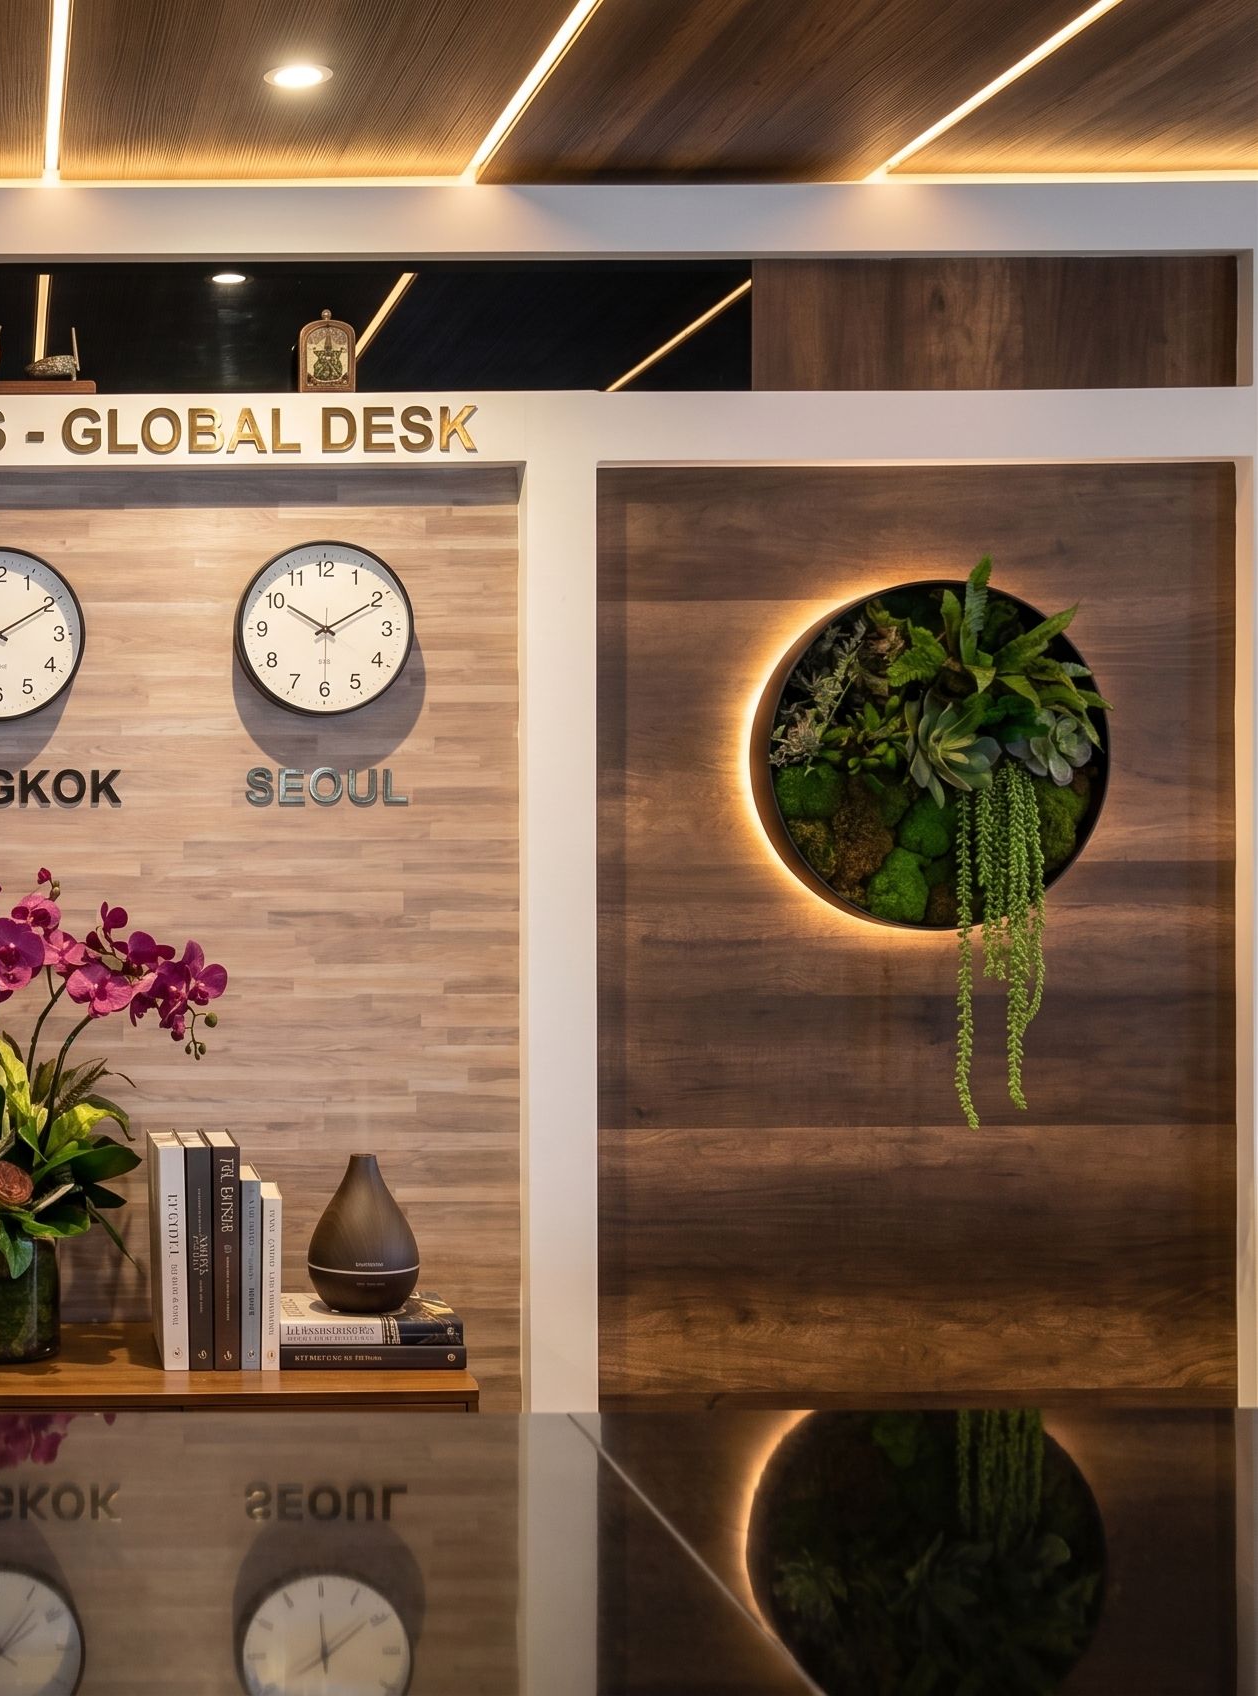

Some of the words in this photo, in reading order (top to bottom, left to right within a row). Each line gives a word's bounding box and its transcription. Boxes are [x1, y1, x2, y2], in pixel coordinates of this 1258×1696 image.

[25, 430, 44, 443] -
[61, 407, 301, 454] GLOBAL
[321, 404, 478, 454] DESK
[315, 560, 335, 577] 12
[351, 569, 358, 585] 1
[23, 575, 30, 591] 1
[287, 570, 303, 586] 11
[43, 596, 55, 613] 2
[265, 592, 285, 609] 10
[371, 591, 383, 607] 2
[53, 625, 65, 642] 3
[256, 620, 268, 637] 9
[381, 620, 392, 637] 3
[44, 656, 57, 672] 4
[266, 651, 278, 668] 8
[371, 651, 383, 668] 4
[22, 678, 33, 695] 5
[289, 673, 301, 689] 7
[319, 681, 330, 697] 6
[349, 673, 361, 690] 5
[245, 767, 409, 807] SEOUL
